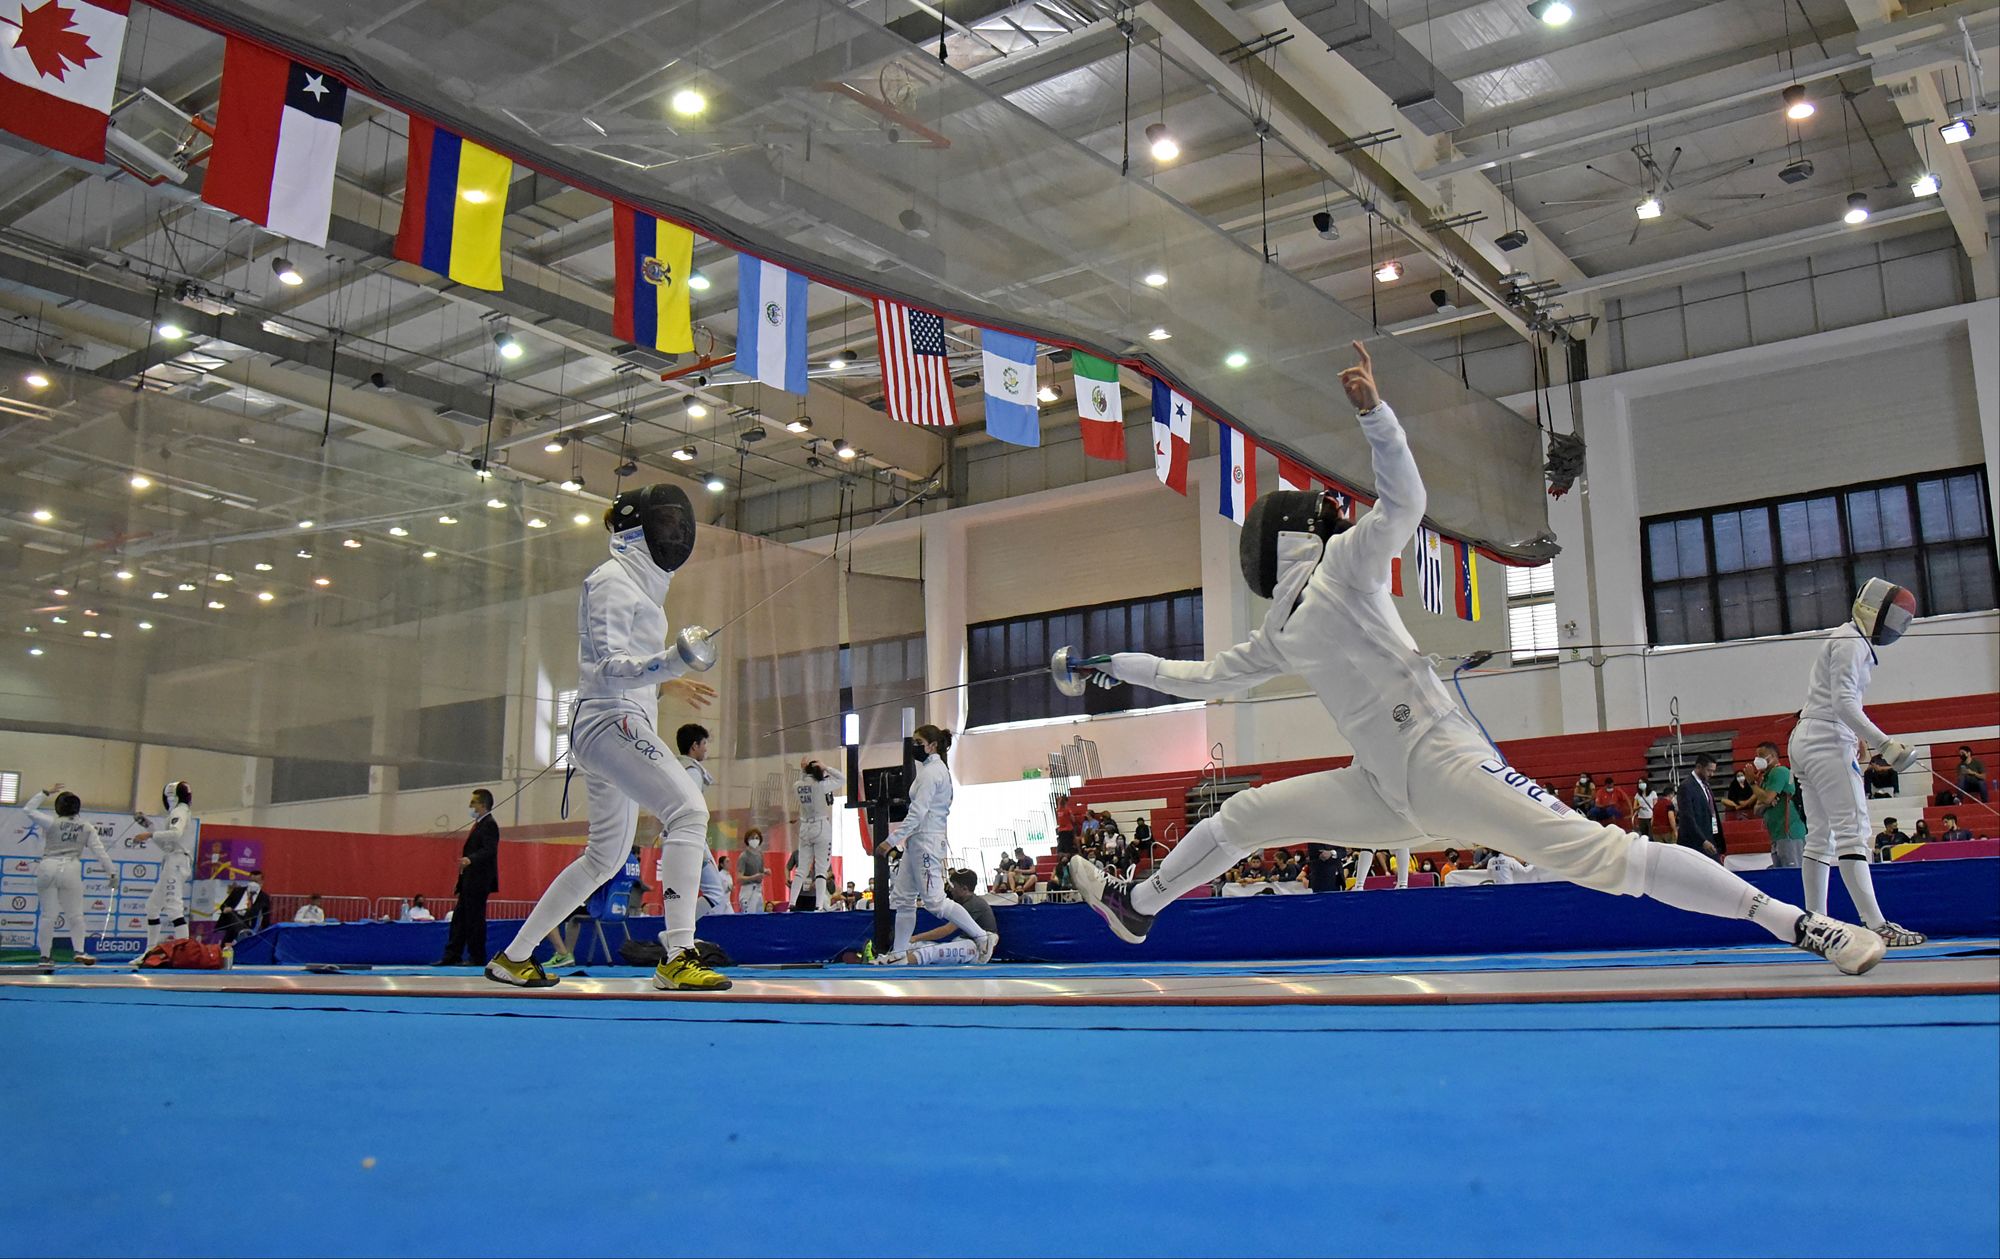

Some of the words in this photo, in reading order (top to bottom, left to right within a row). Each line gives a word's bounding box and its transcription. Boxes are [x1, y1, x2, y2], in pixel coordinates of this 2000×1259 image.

[635, 739, 664, 761] CRC
[61, 832, 79, 842] CAN
[625, 862, 641, 876] USA
